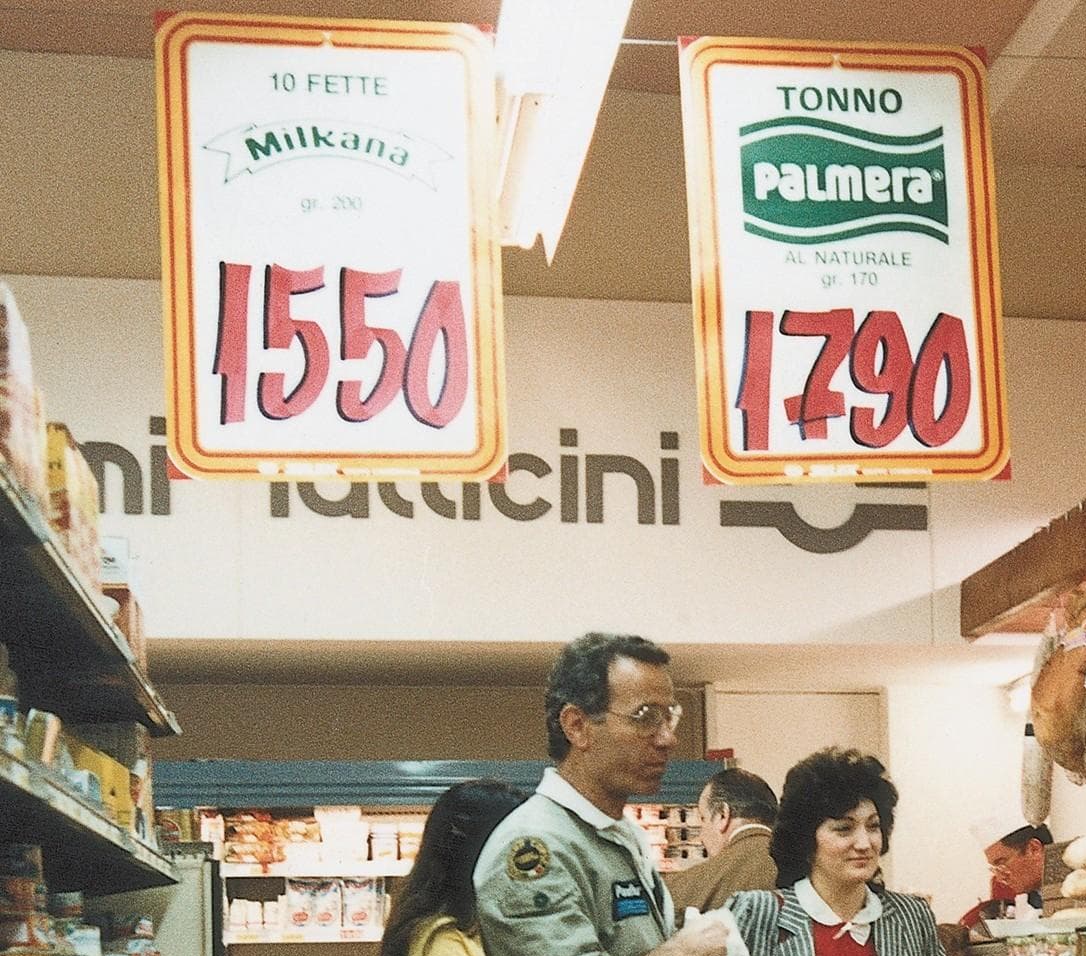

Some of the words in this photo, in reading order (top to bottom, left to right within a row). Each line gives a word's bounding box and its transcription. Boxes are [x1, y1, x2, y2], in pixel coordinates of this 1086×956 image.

[271, 73, 296, 93] 10
[307, 74, 389, 96] FETTE
[776, 86, 903, 114] TONNO
[244, 125, 411, 167] Milkana
[785, 251, 804, 266] AL
[815, 251, 912, 268] NATURALE
[821, 272, 843, 288] gr.
[850, 272, 878, 287] 170
[212, 260, 469, 429] 1550
[735, 308, 971, 450] 1790
